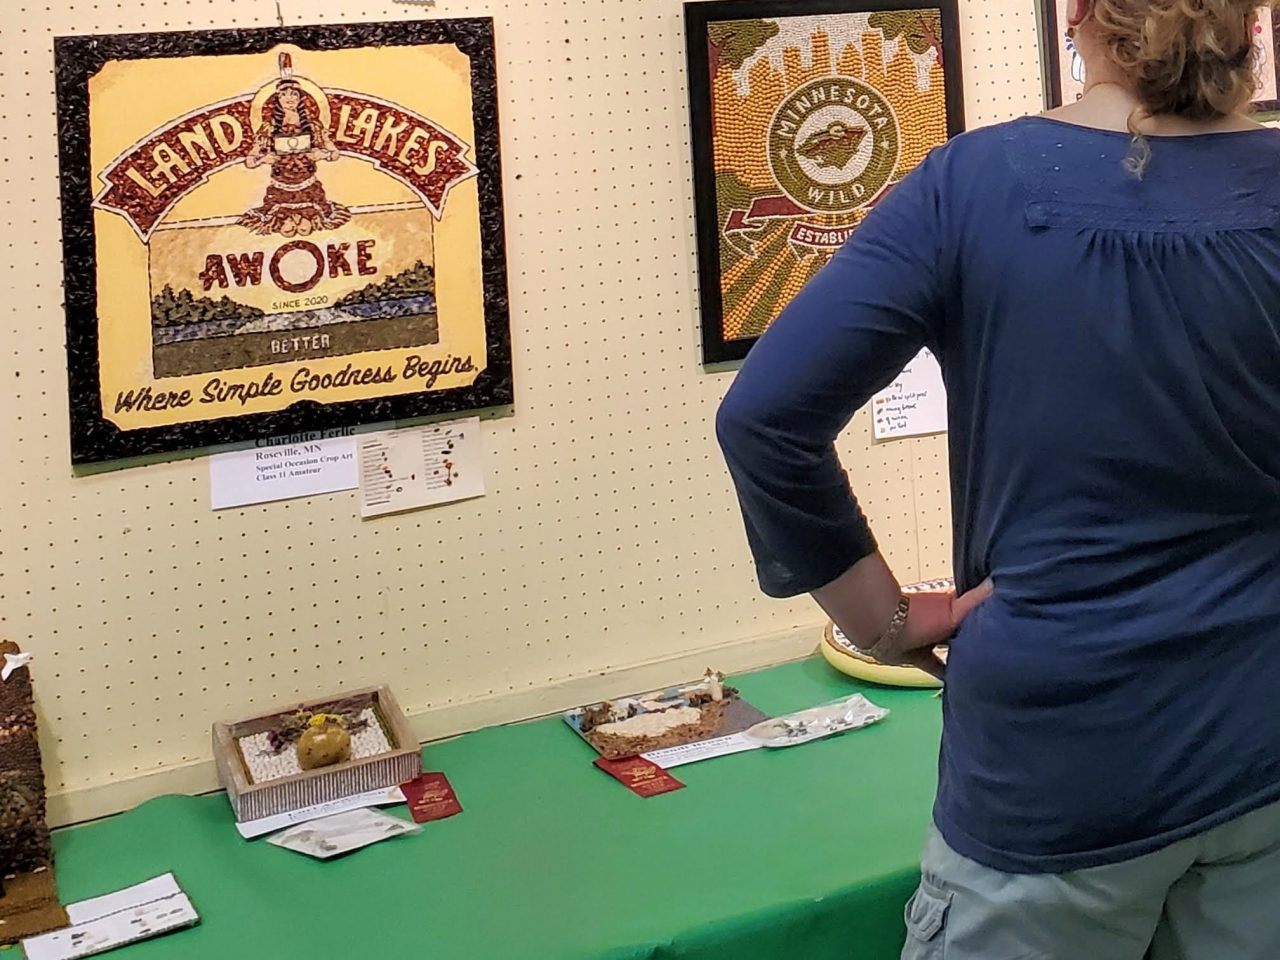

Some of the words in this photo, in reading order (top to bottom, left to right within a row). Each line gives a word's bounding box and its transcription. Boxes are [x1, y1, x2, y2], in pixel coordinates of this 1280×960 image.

[776, 87, 889, 138] MINNESOTA
[125, 114, 244, 198] LAND
[336, 103, 449, 177] LAKES
[807, 181, 867, 205] WILD
[199, 239, 378, 293] AWOKE
[271, 299, 301, 311] SINCE
[304, 294, 329, 307] 2020
[271, 334, 331, 354] BETTER
[114, 385, 192, 414] Where
[199, 372, 283, 408] Simple
[289, 365, 398, 396] Goodness
[304, 444, 322, 455] MN
[256, 462, 283, 473] Special
[284, 457, 319, 469] Occasion
[320, 454, 340, 465] Crop
[340, 453, 353, 461] Art
[256, 472, 278, 482] Class
[289, 467, 321, 478] Amateur
